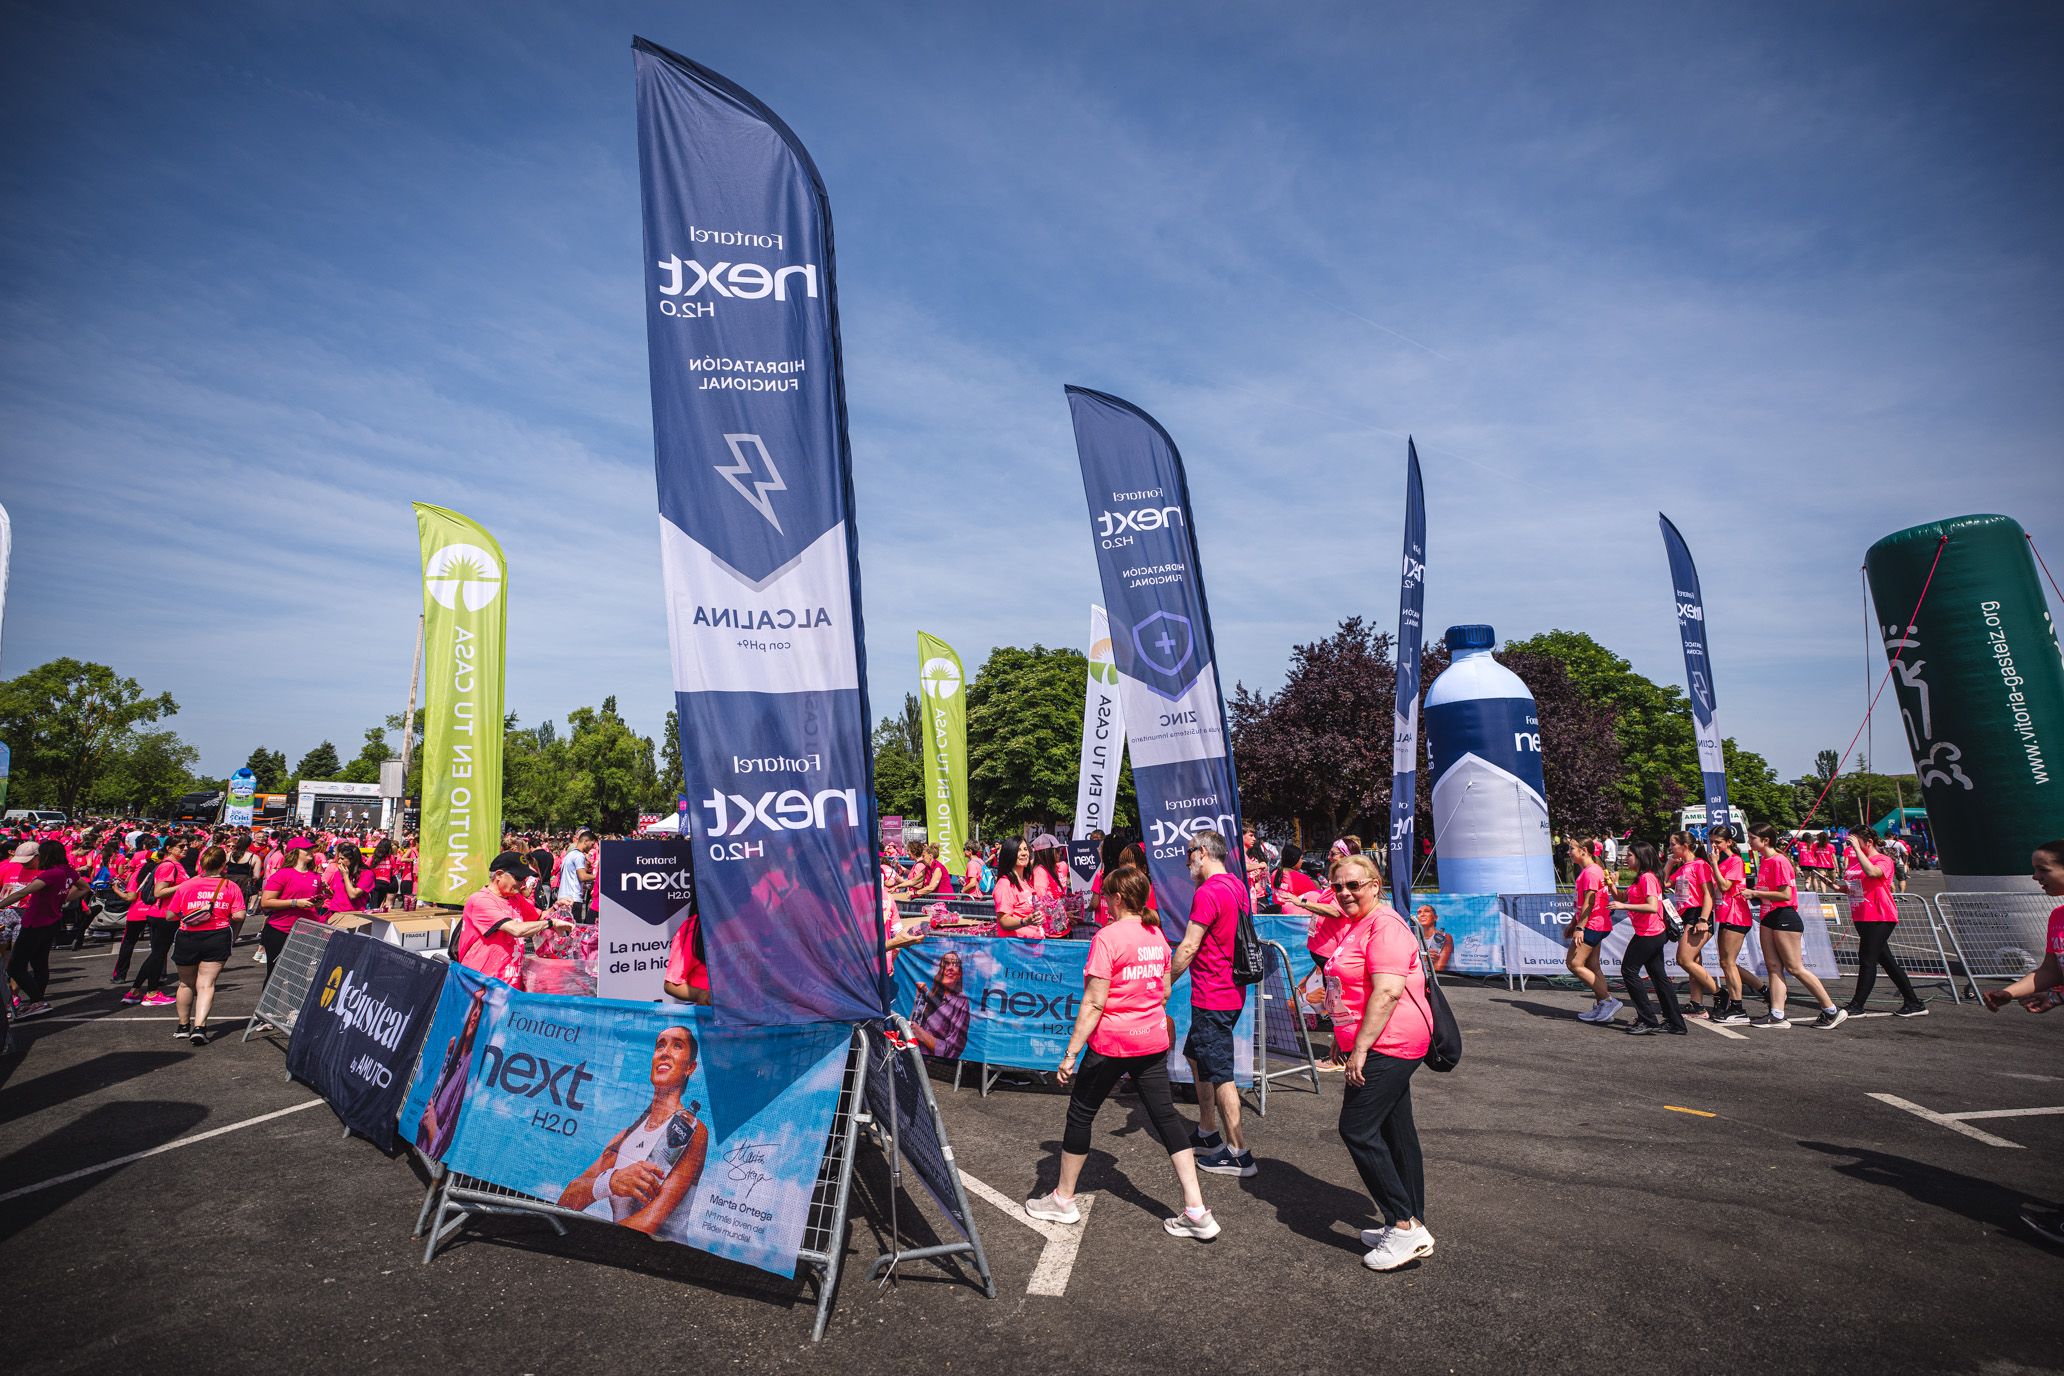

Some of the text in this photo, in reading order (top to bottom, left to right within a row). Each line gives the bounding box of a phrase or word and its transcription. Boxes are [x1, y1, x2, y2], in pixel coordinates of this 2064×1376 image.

[1981, 600, 2049, 785] www.vitoria-gasteiz.org
[636, 856, 677, 865] Fontarel
[1074, 854, 1096, 866] next
[621, 868, 691, 891] next
[667, 891, 691, 900] H2.0
[609, 941, 628, 954] La
[1137, 946, 1164, 962] SOMOS
[609, 961, 630, 974] de
[634, 959, 647, 972] la
[1524, 957, 1566, 965] La nuev
[1005, 967, 1063, 983] Fontarel
[981, 988, 1081, 1020] next
[507, 1010, 581, 1043] Fontarel
[478, 1045, 594, 1111] next
[531, 1109, 577, 1137] H2.0
[709, 1194, 773, 1221] Marta Ortega
[732, 1217, 752, 1230] joven
[752, 1225, 765, 1234] del
[722, 1229, 751, 1243] mundial
